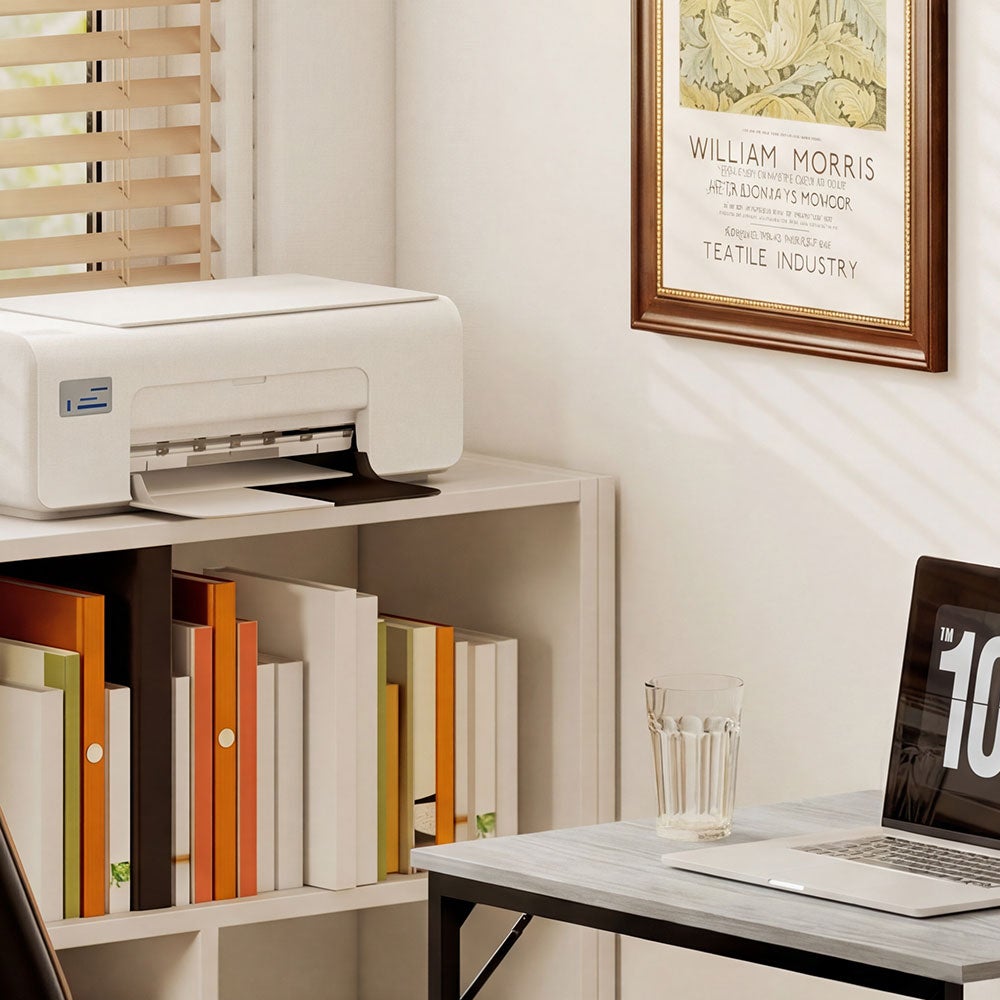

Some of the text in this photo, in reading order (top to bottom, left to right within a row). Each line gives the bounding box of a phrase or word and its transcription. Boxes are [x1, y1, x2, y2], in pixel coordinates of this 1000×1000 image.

[689, 135, 777, 168] WILLIAM
[793, 148, 875, 182] MORRIS
[703, 241, 858, 280] TEATILE INDUSTRY
